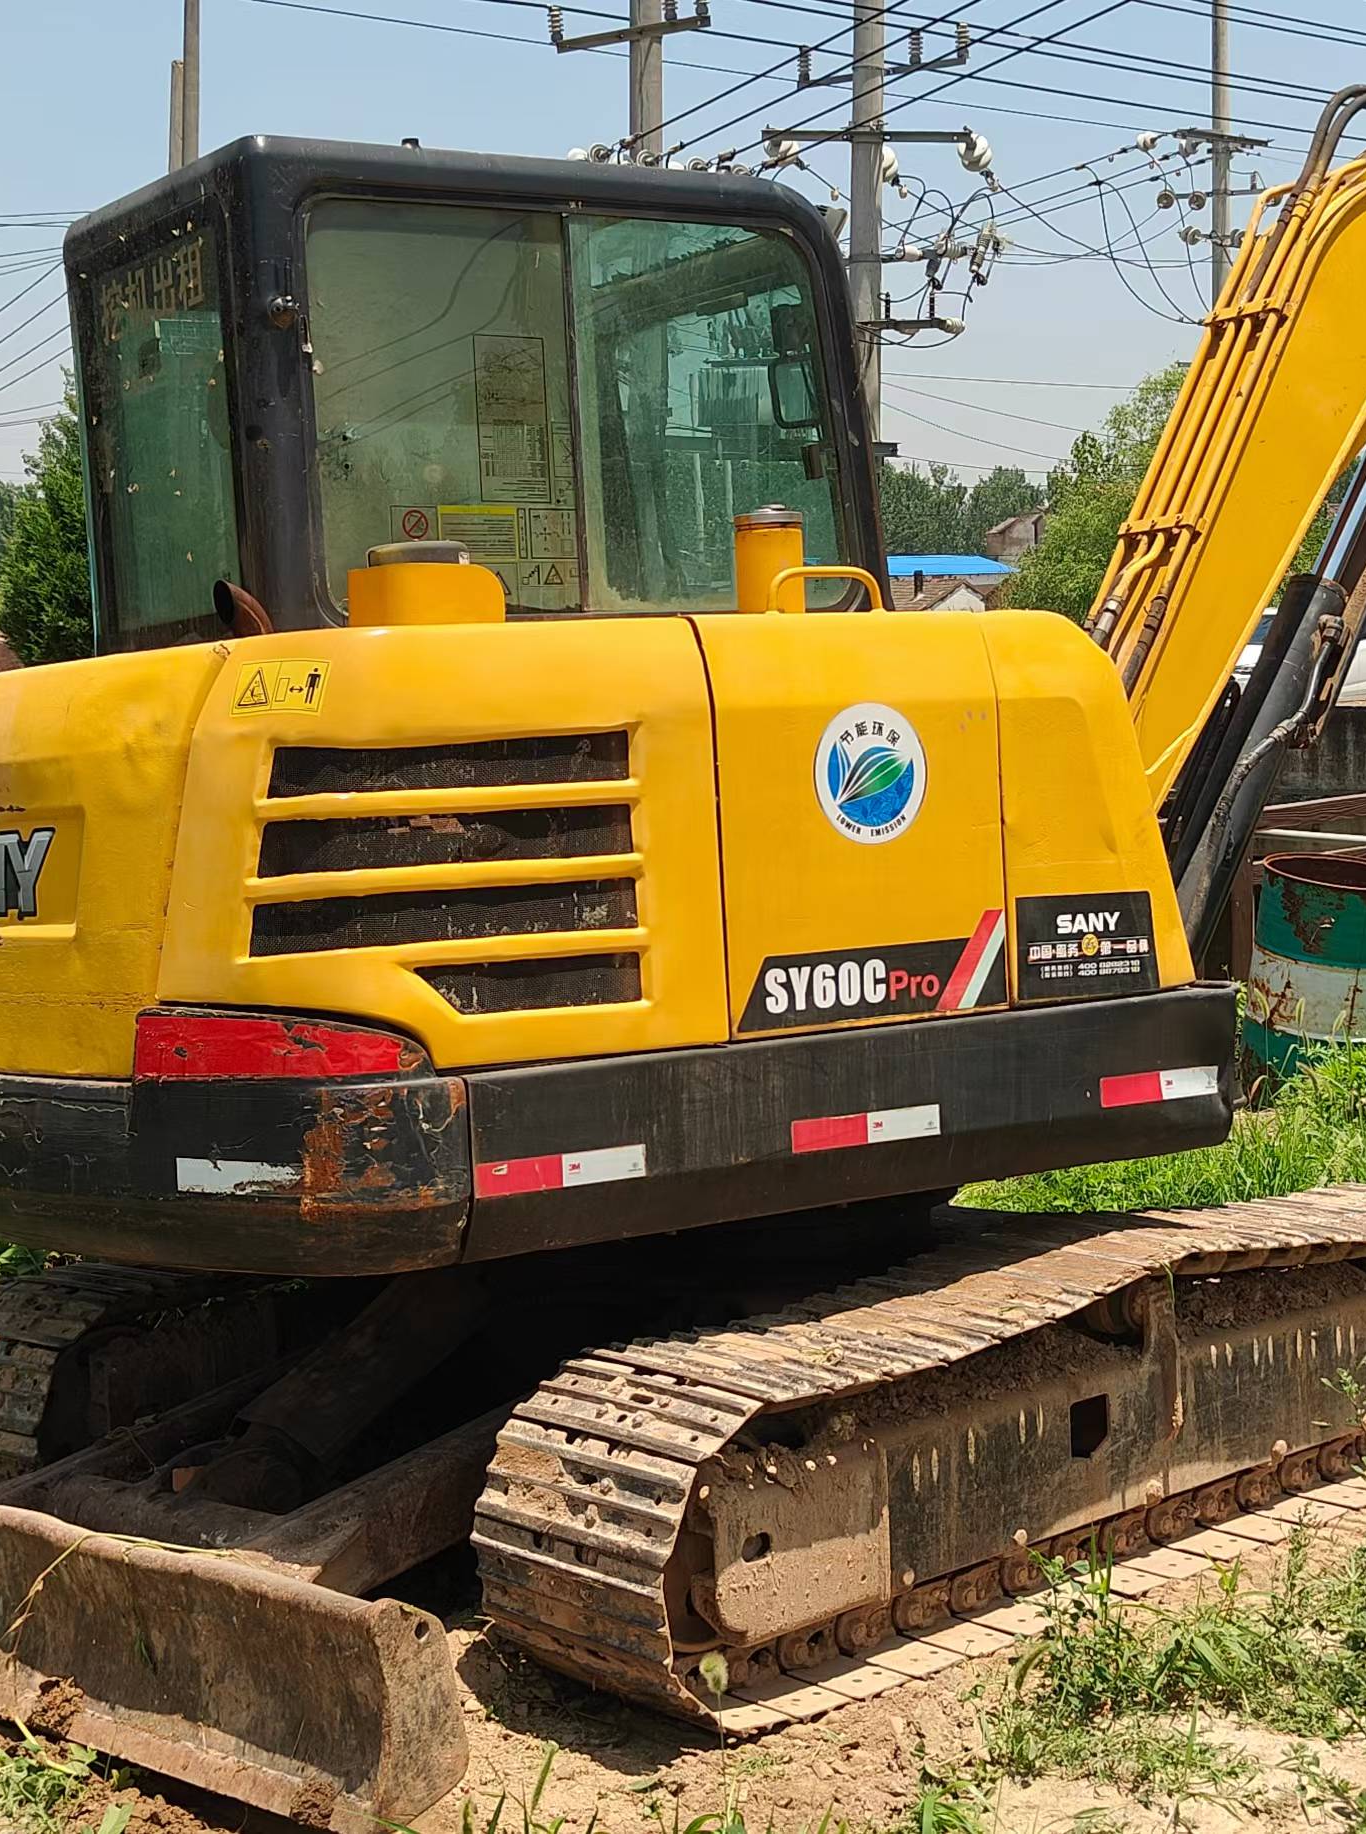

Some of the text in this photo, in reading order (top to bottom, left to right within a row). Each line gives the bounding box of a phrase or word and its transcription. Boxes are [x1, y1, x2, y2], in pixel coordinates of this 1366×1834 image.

[839, 720, 901, 746] 节能环保
[836, 813, 906, 837] LOWER EMISSION
[1056, 911, 1121, 934] SANY
[568, 1162, 581, 1171] 3M
